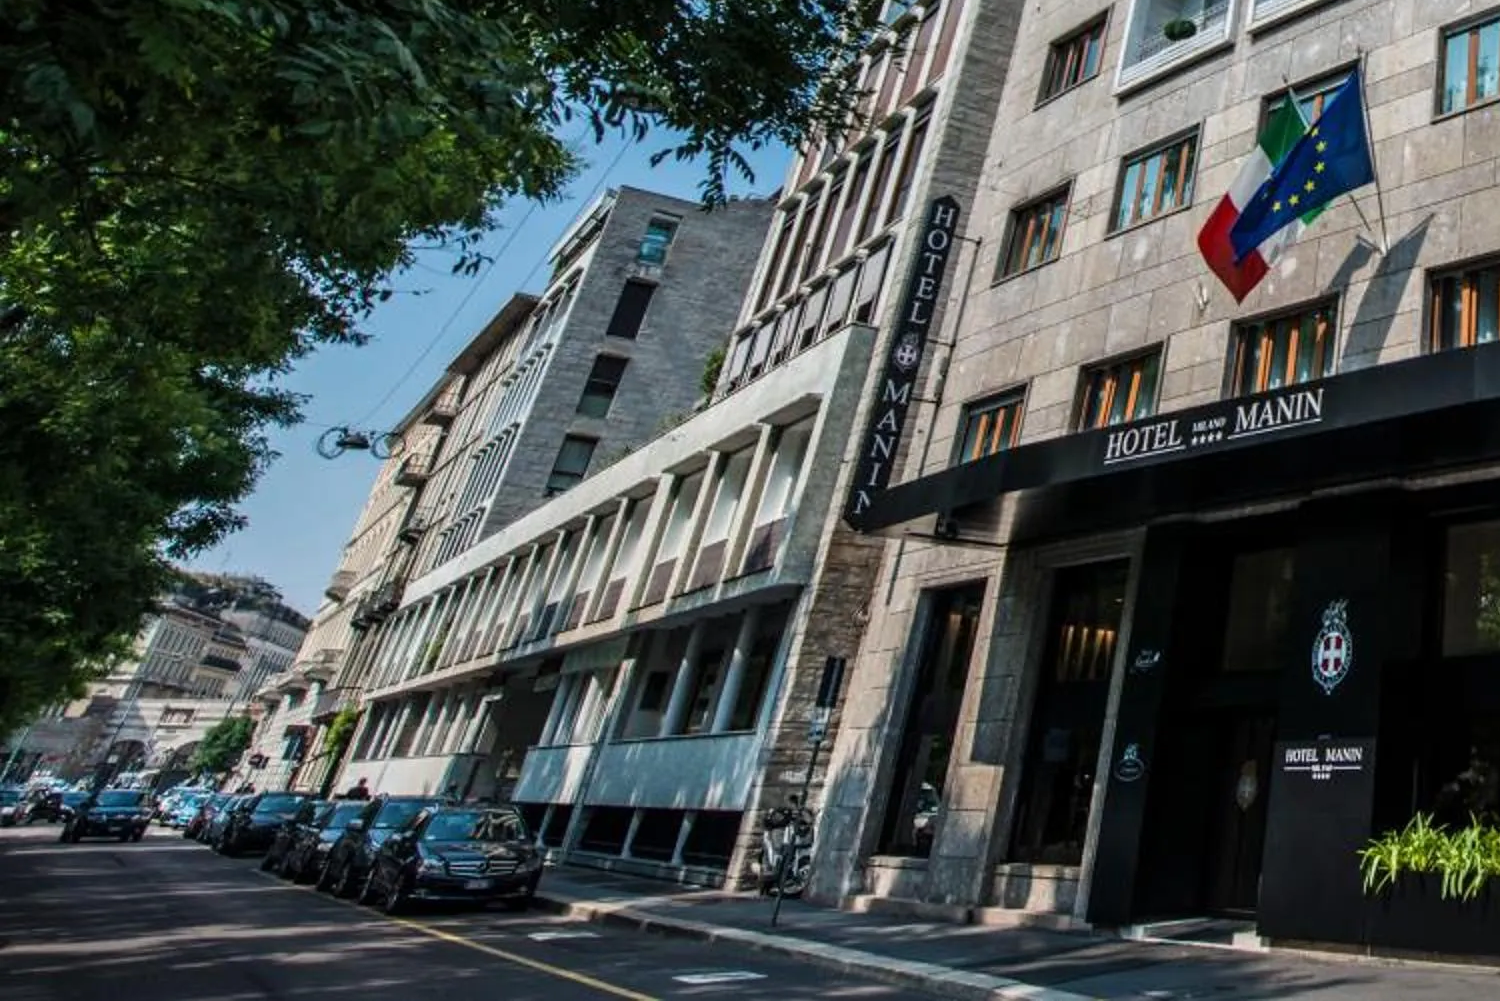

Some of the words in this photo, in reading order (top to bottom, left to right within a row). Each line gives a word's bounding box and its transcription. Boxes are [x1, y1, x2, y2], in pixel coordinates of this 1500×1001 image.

[910, 206, 955, 324] HOTEL
[1105, 420, 1182, 459] HOTEL
[1235, 388, 1324, 432] MANIN
[1285, 749, 1318, 762] HOTEL
[1325, 747, 1363, 762] MANIN
